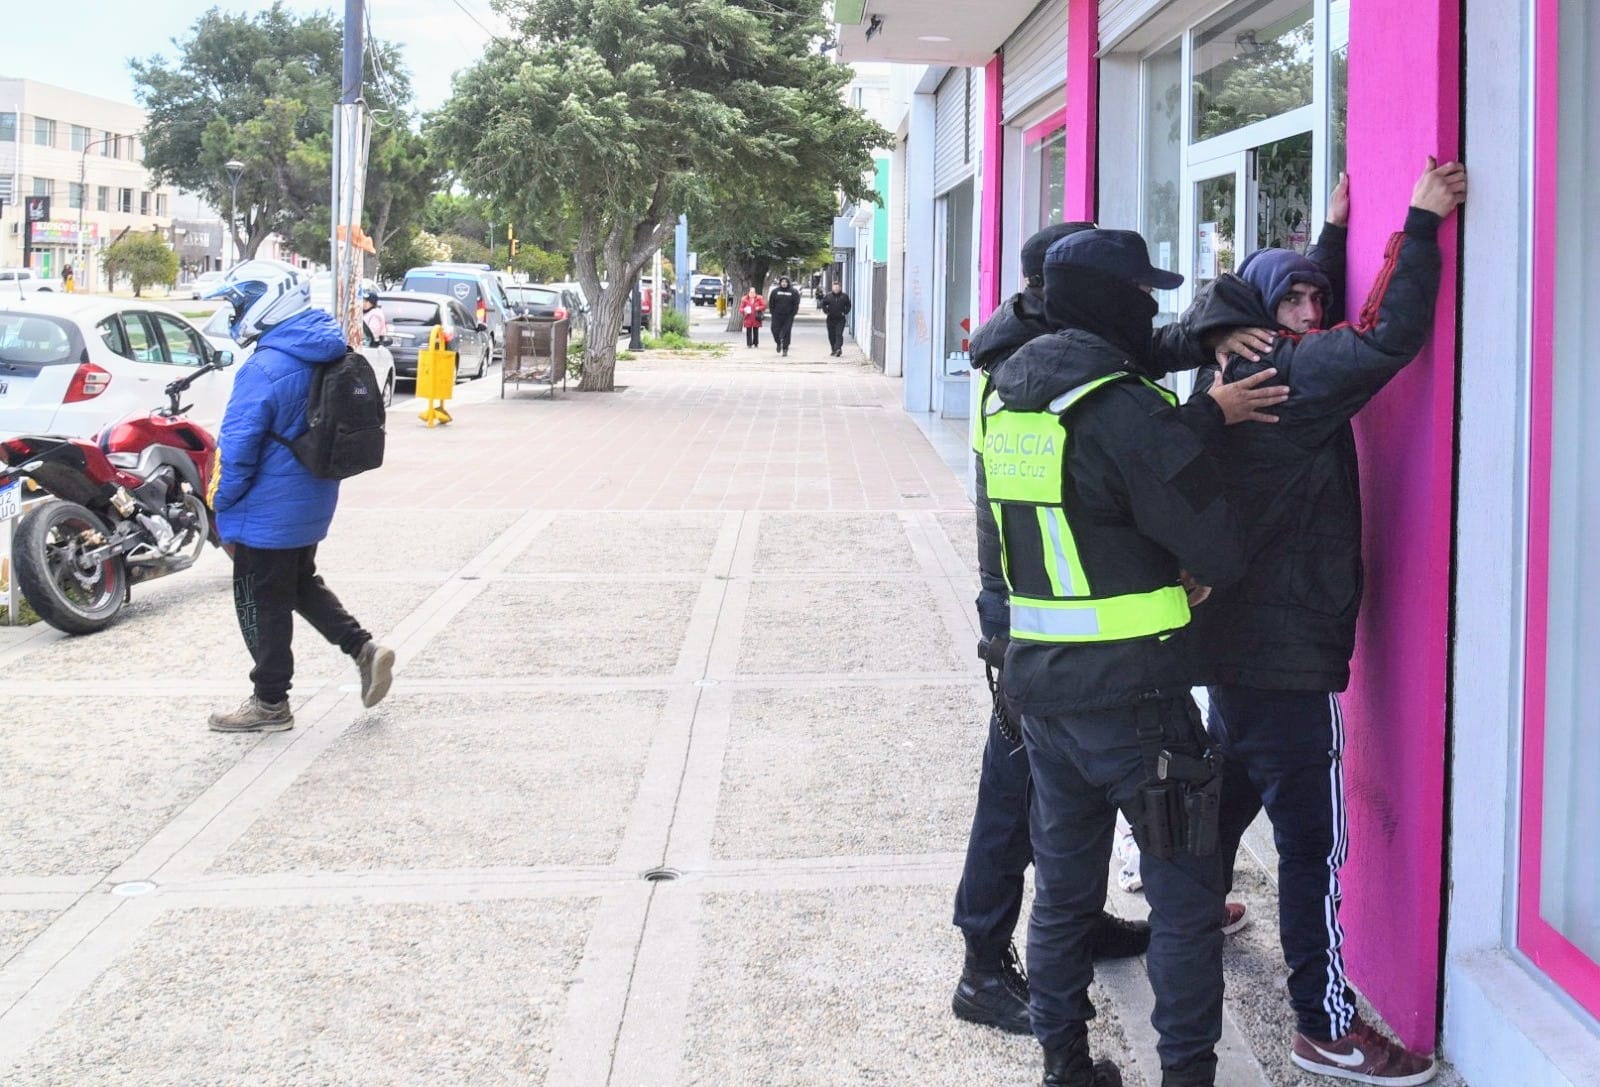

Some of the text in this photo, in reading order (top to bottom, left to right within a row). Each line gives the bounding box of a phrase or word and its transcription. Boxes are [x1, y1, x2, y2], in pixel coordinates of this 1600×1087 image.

[985, 433, 1056, 456] POLICIA
[989, 459, 1047, 478] Santa Cruz
